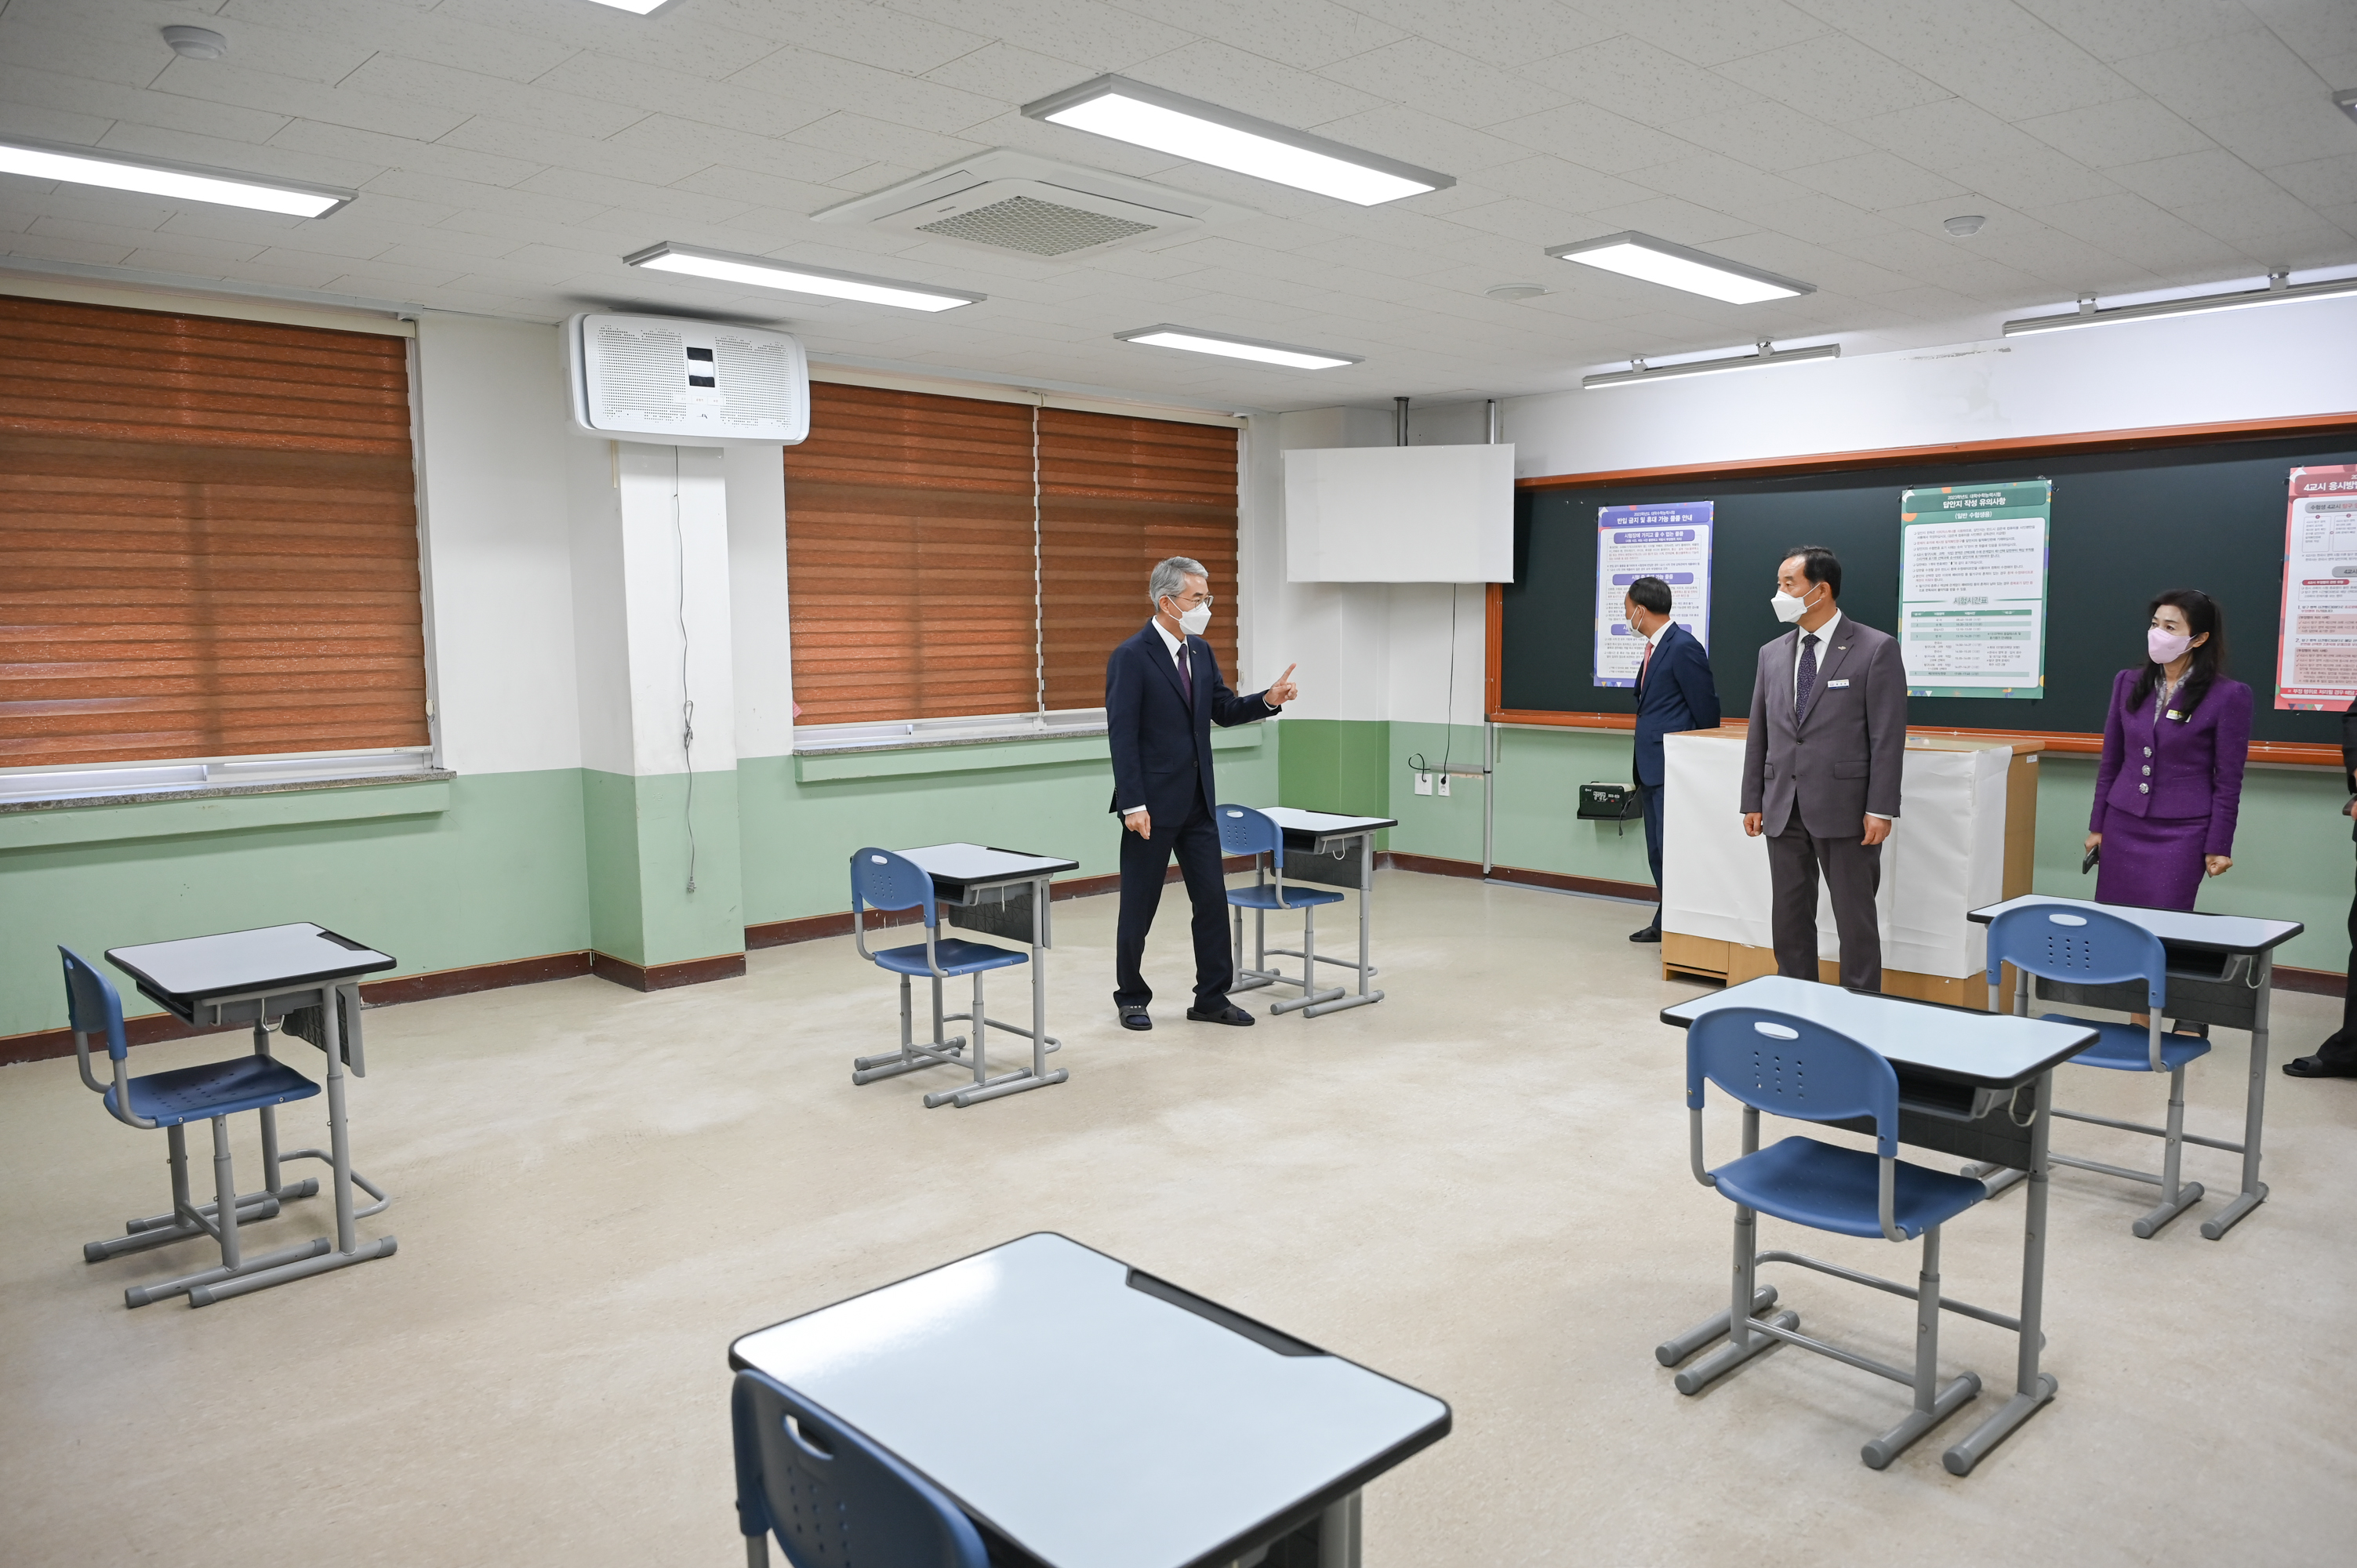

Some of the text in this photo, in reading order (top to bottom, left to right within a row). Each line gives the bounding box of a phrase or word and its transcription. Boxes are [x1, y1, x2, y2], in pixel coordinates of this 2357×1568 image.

[2304, 482, 2326, 491] 4교시
[1943, 500, 1962, 508] 답안지
[1979, 497, 2006, 506] 유의사항
